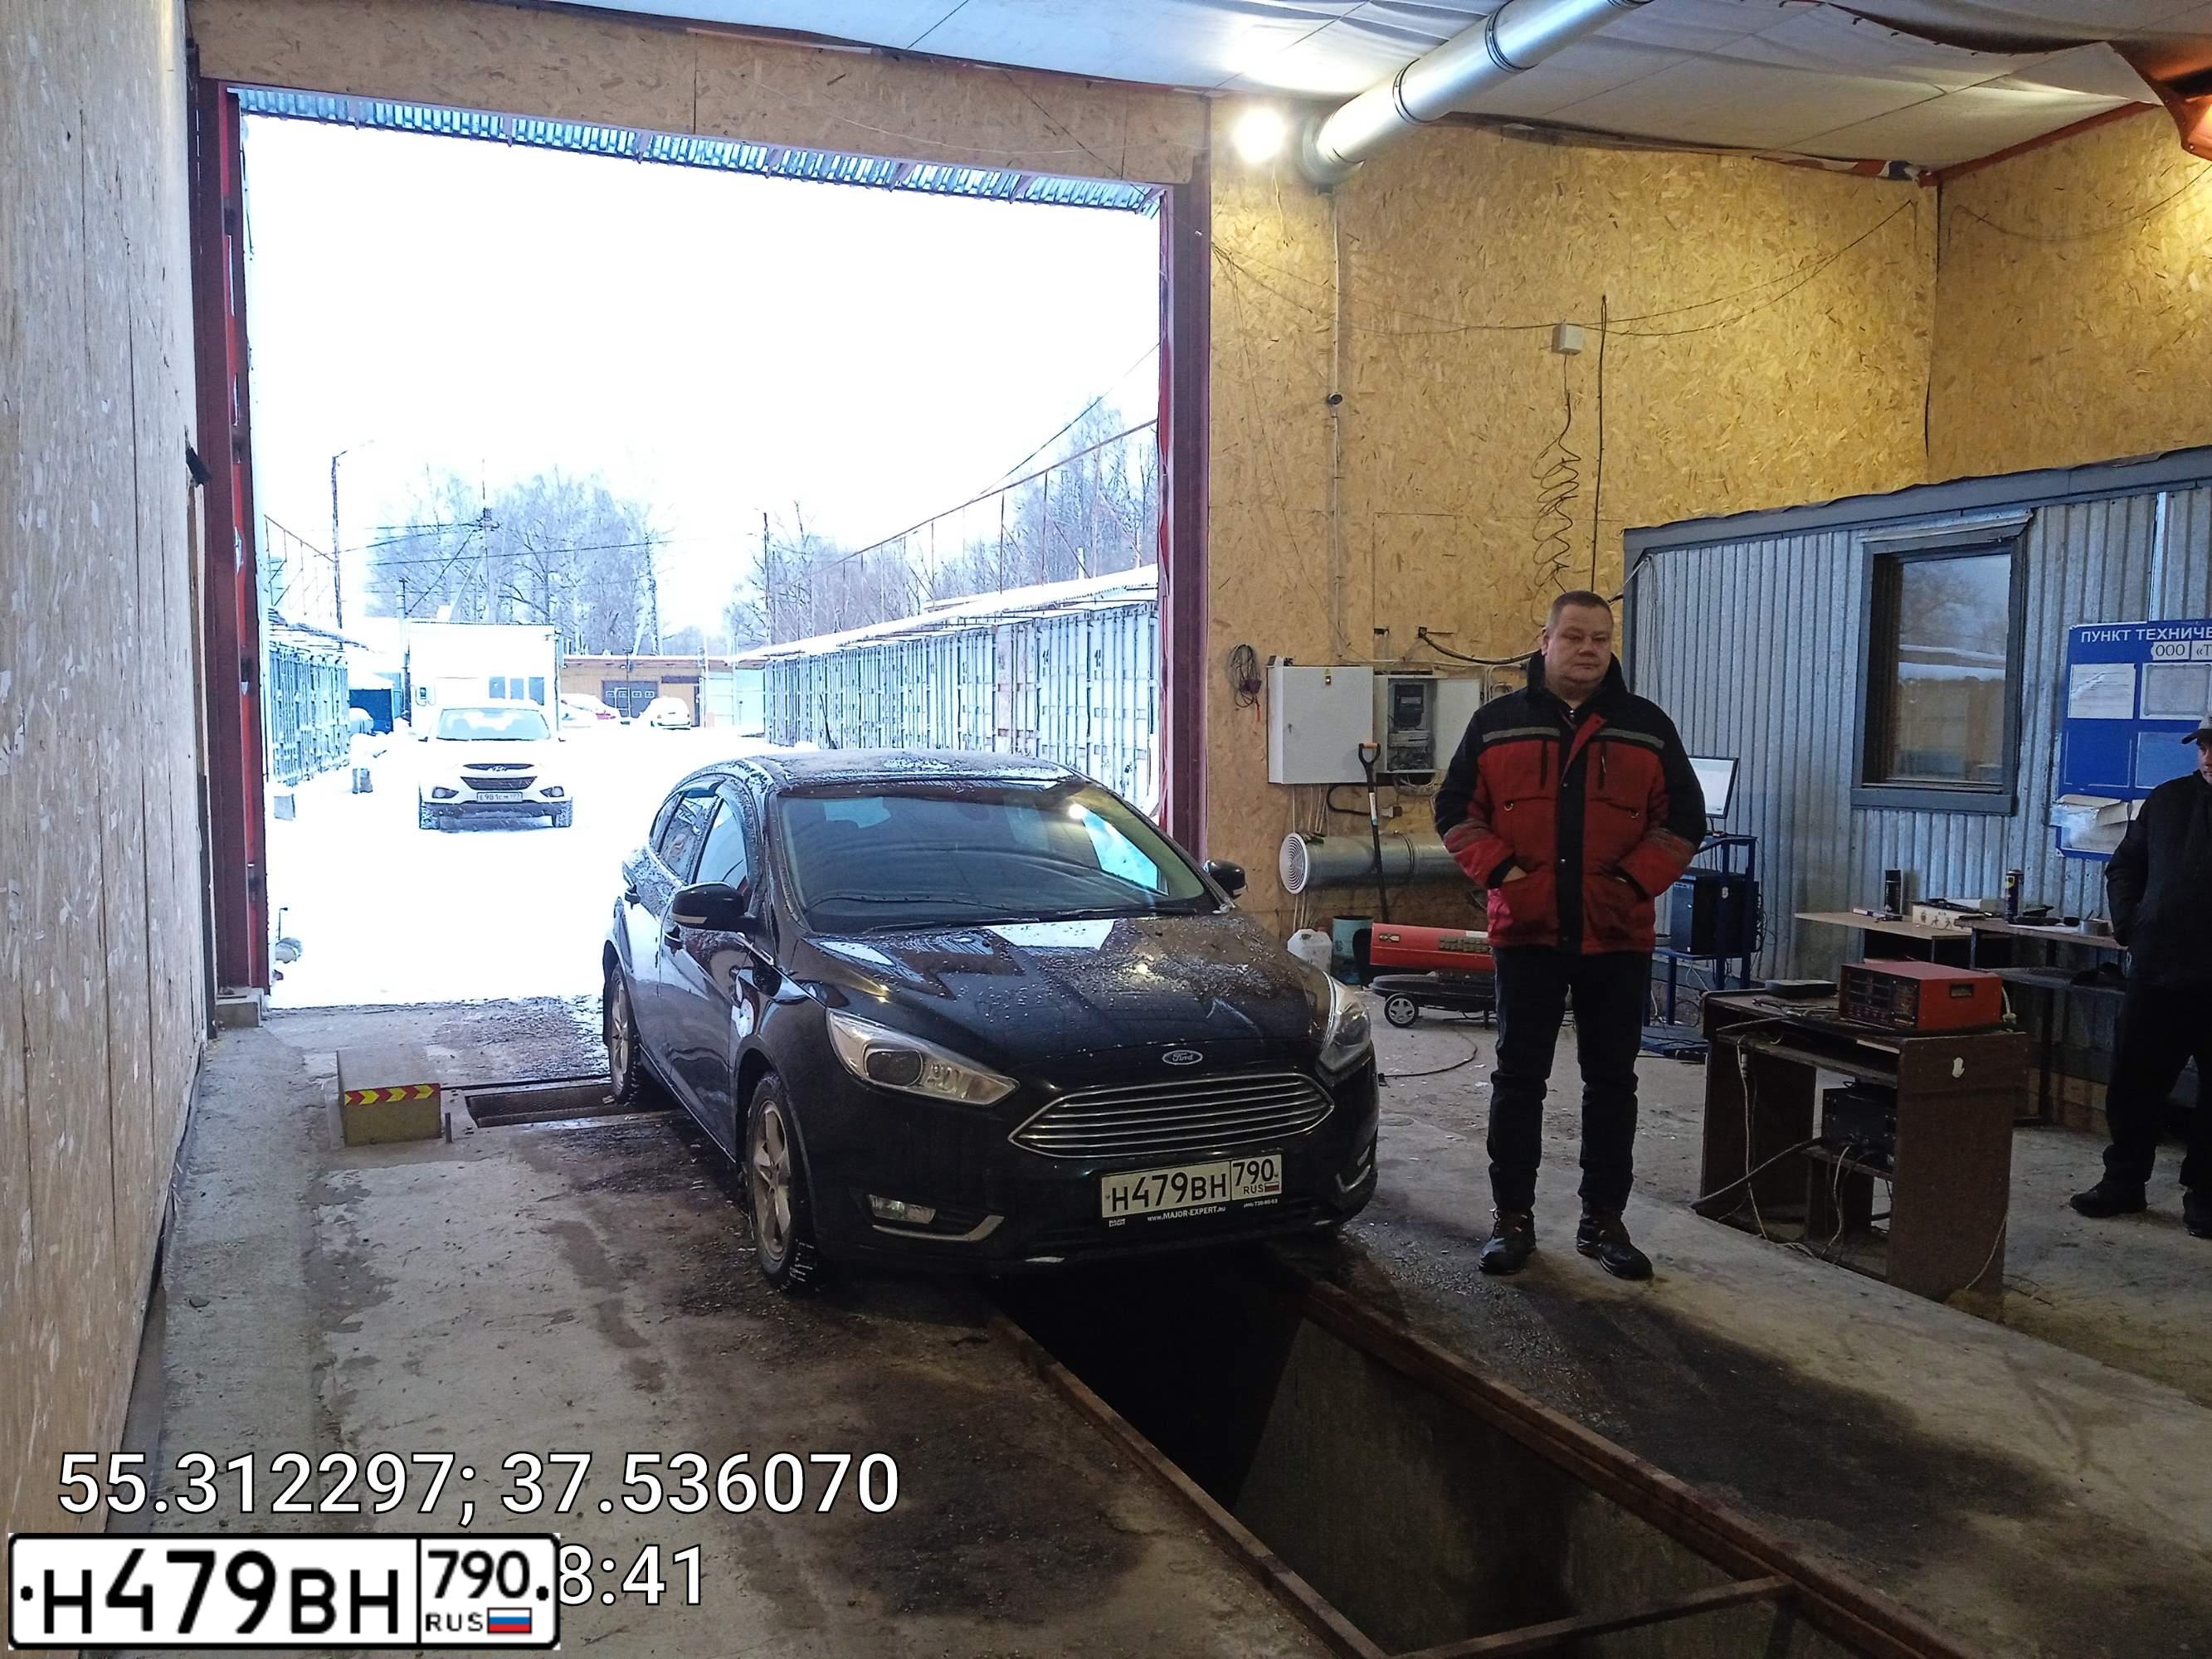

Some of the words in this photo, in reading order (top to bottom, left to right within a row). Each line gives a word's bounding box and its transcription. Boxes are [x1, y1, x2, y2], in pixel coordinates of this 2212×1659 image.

[2081, 630, 2132, 643] ПУНКТ
[1172, 1052, 1194, 1062] Ford
[1112, 1171, 1226, 1212] Н479ВН
[1232, 1158, 1274, 1186] 790
[1243, 1183, 1264, 1194] RUS
